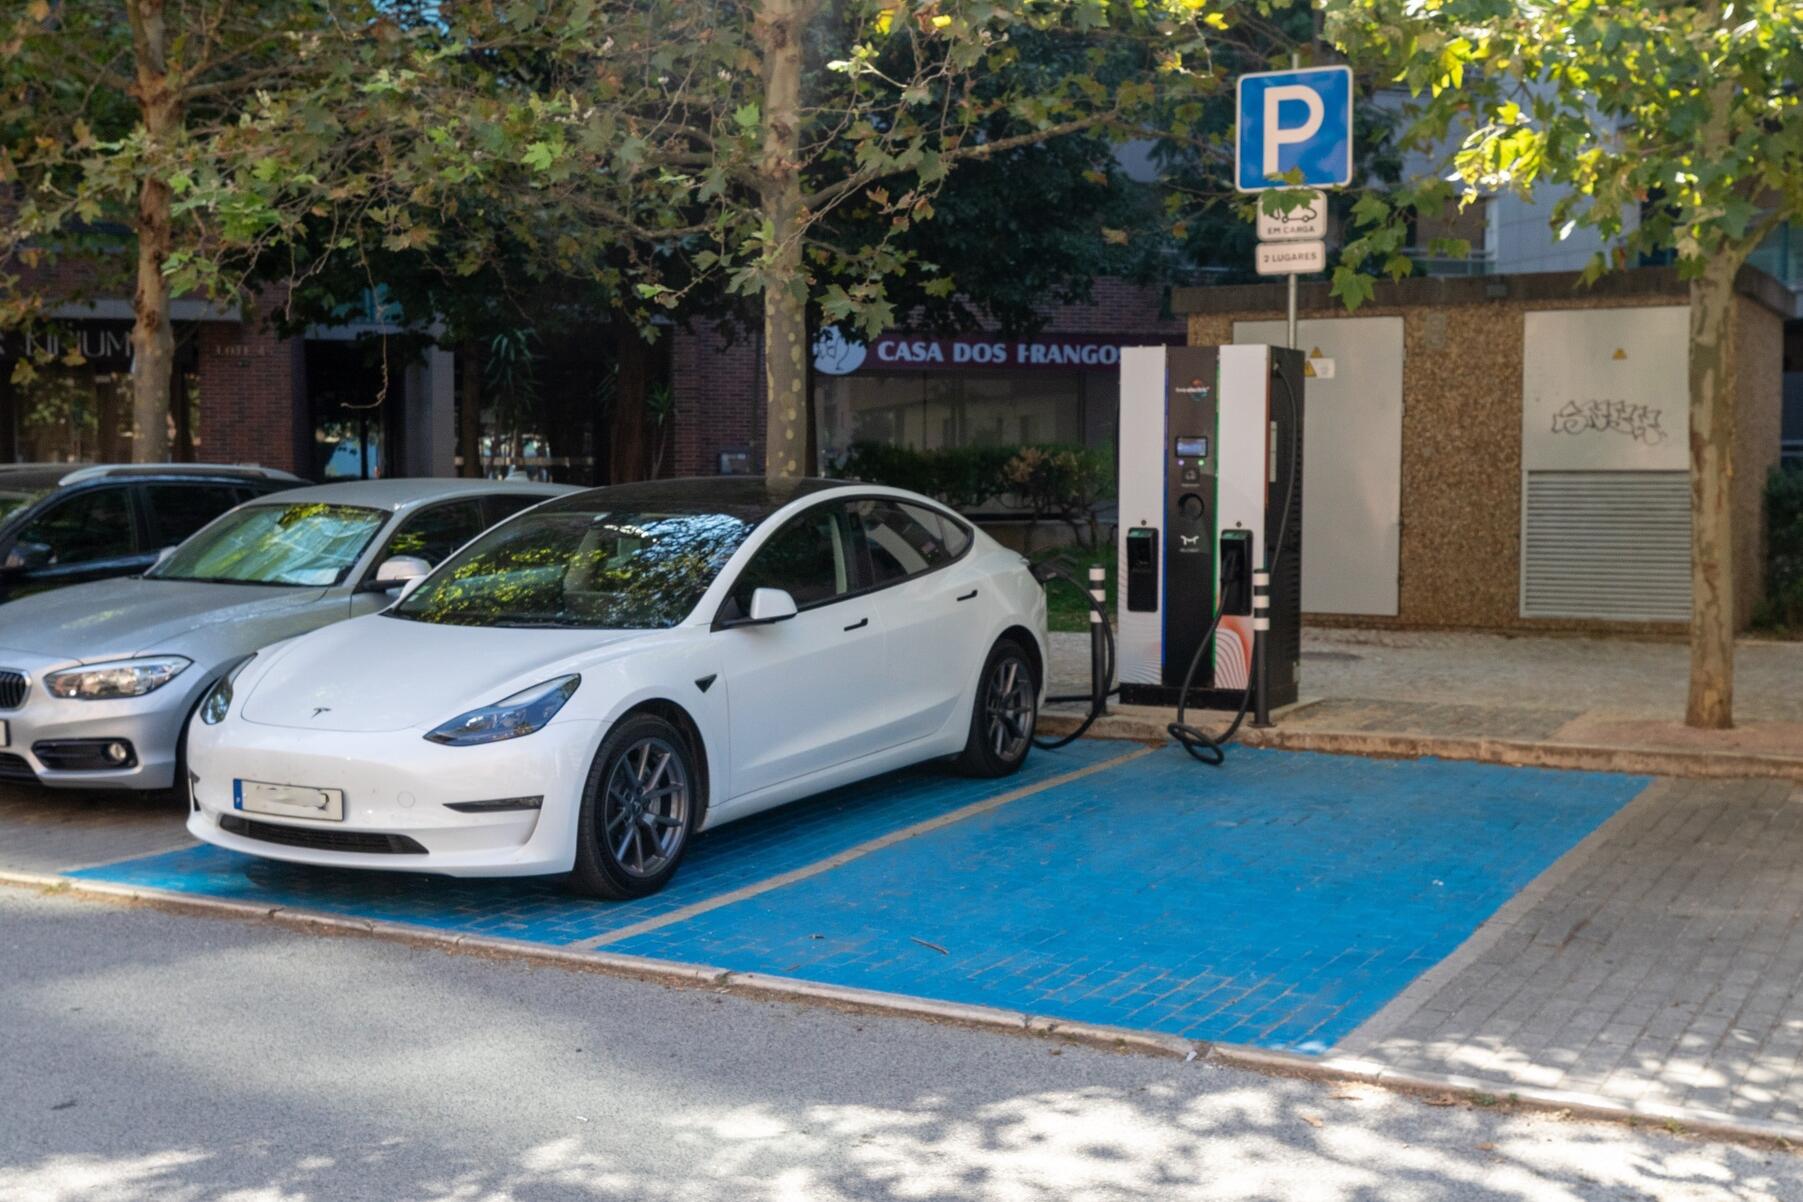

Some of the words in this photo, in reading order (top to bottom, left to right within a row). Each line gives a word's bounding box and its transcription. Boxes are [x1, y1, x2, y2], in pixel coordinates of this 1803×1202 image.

[1263, 84, 1325, 177] P
[1267, 227, 1280, 235] EM
[1283, 225, 1315, 234] CARGA
[1263, 254, 1270, 263] 2
[1272, 252, 1317, 263] LUGARES
[877, 341, 944, 363] CASA
[953, 342, 1007, 363] DOS
[1016, 343, 1121, 364] FRANGO
